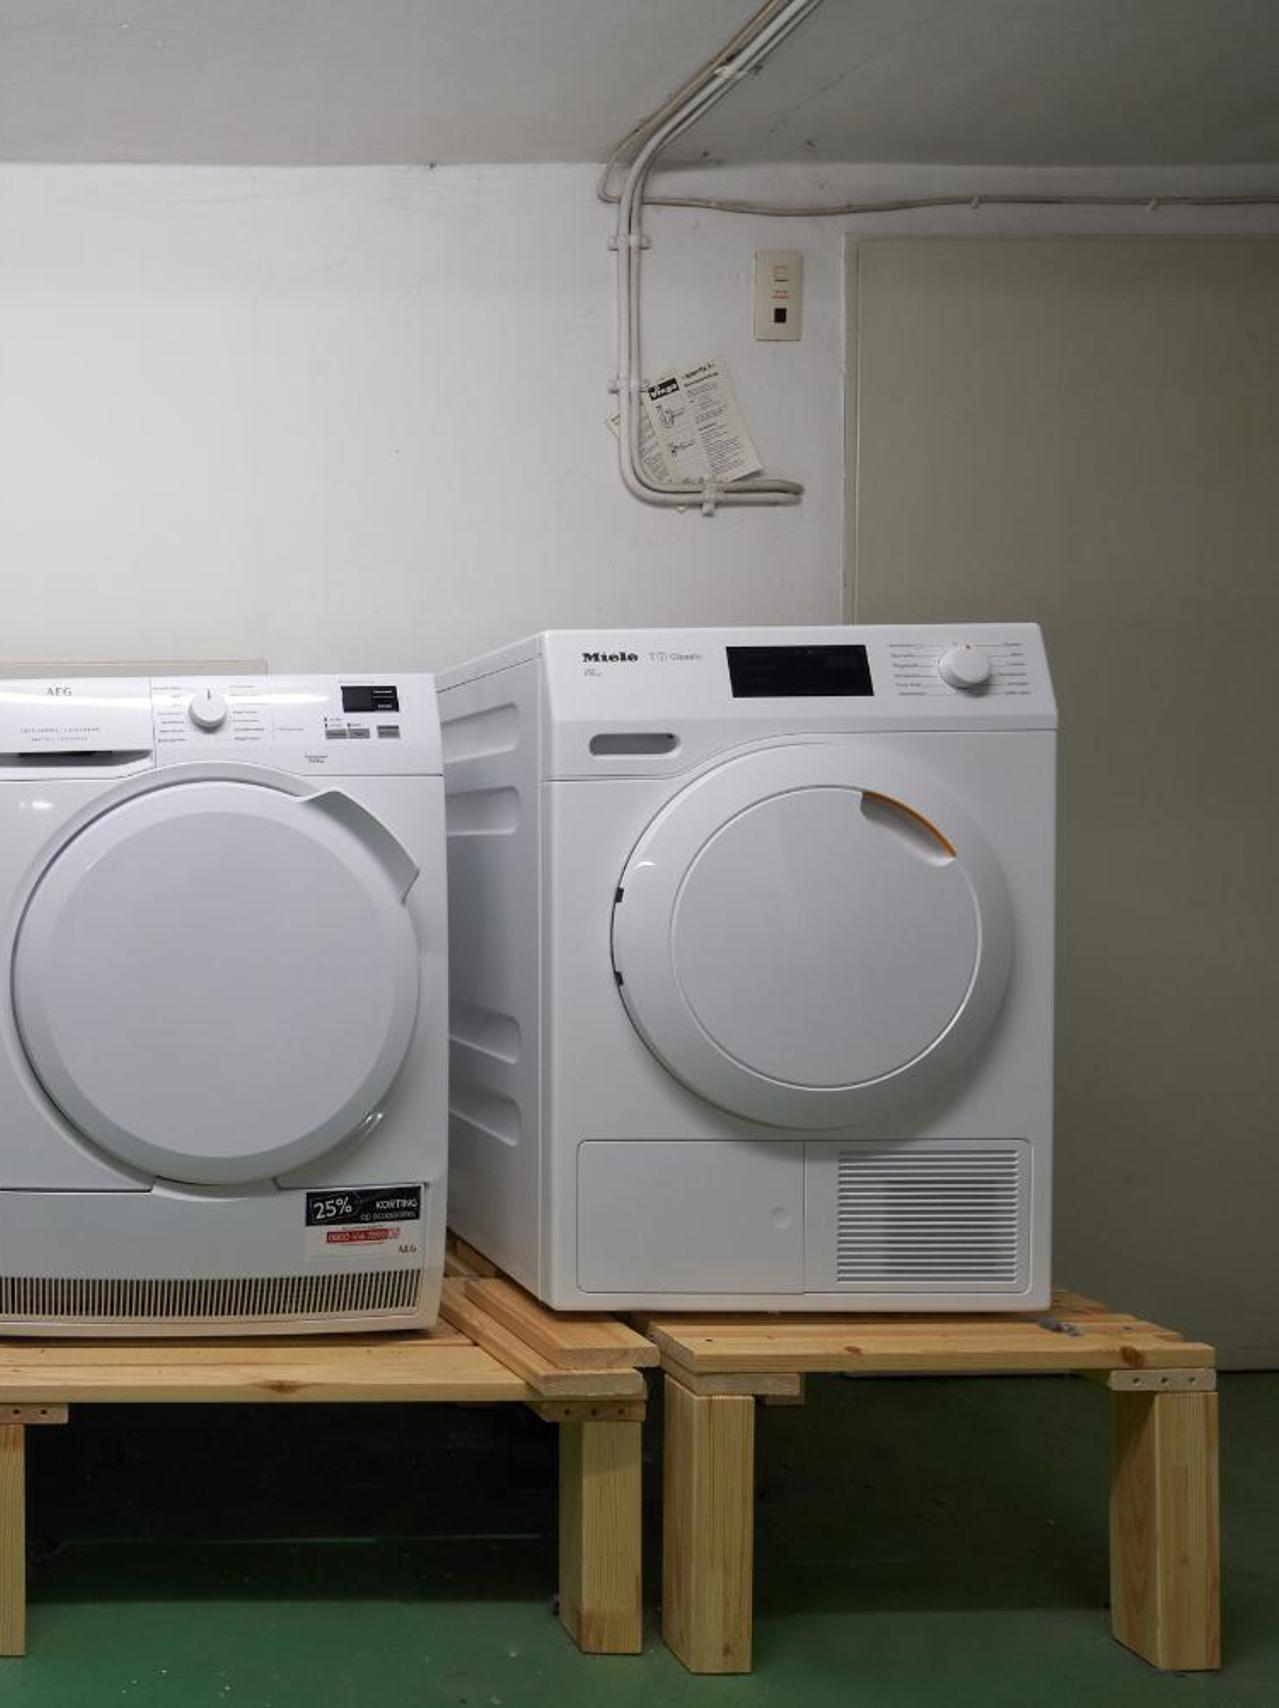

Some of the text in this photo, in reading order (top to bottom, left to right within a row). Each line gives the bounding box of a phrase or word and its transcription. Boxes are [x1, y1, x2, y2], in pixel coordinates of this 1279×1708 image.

[582, 651, 639, 662] Miele
[46, 687, 72, 697] AEG
[313, 1197, 353, 1219] 25%
[376, 1199, 417, 1209] KORTING
